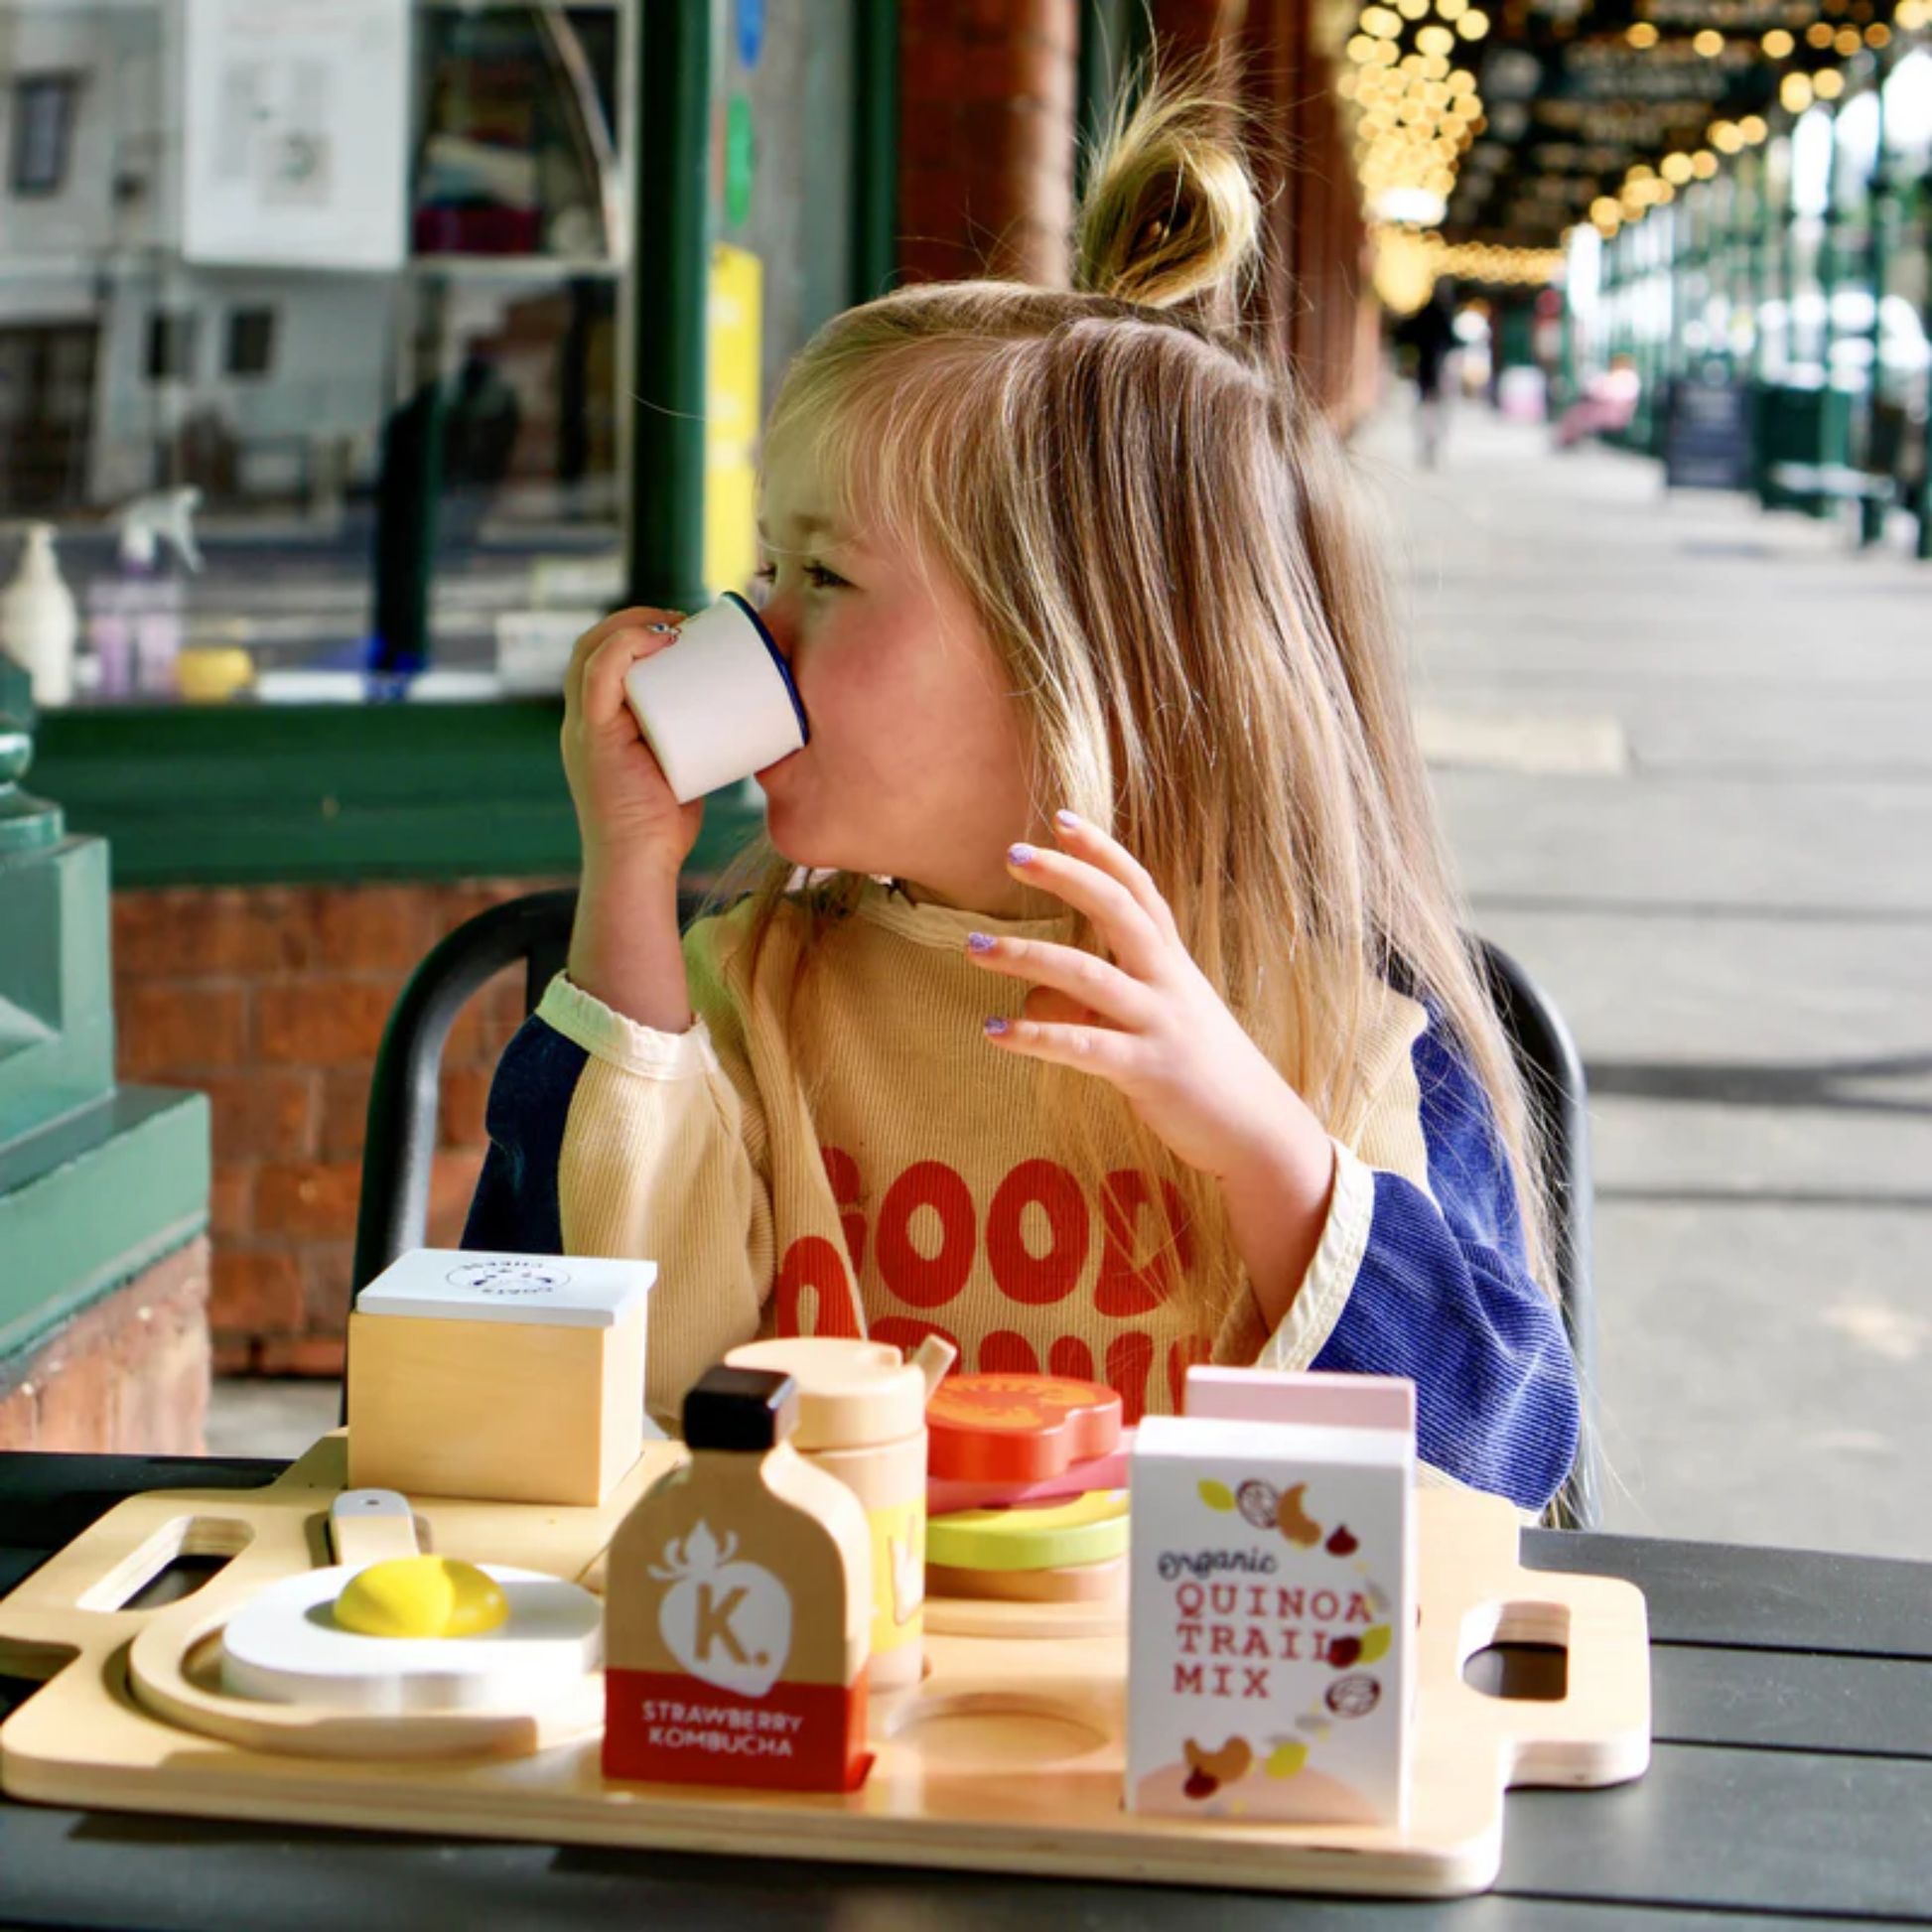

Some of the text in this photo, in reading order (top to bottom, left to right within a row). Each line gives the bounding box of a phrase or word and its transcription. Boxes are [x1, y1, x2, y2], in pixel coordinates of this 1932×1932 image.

[1158, 1546, 1278, 1581] organic
[1175, 1582, 1372, 1623] QUINOA
[696, 1581, 769, 1667] K.
[1173, 1662, 1269, 1699] MIX
[642, 1700, 803, 1732] STRAWBERRY
[649, 1726, 793, 1756] KOMBUCHA
